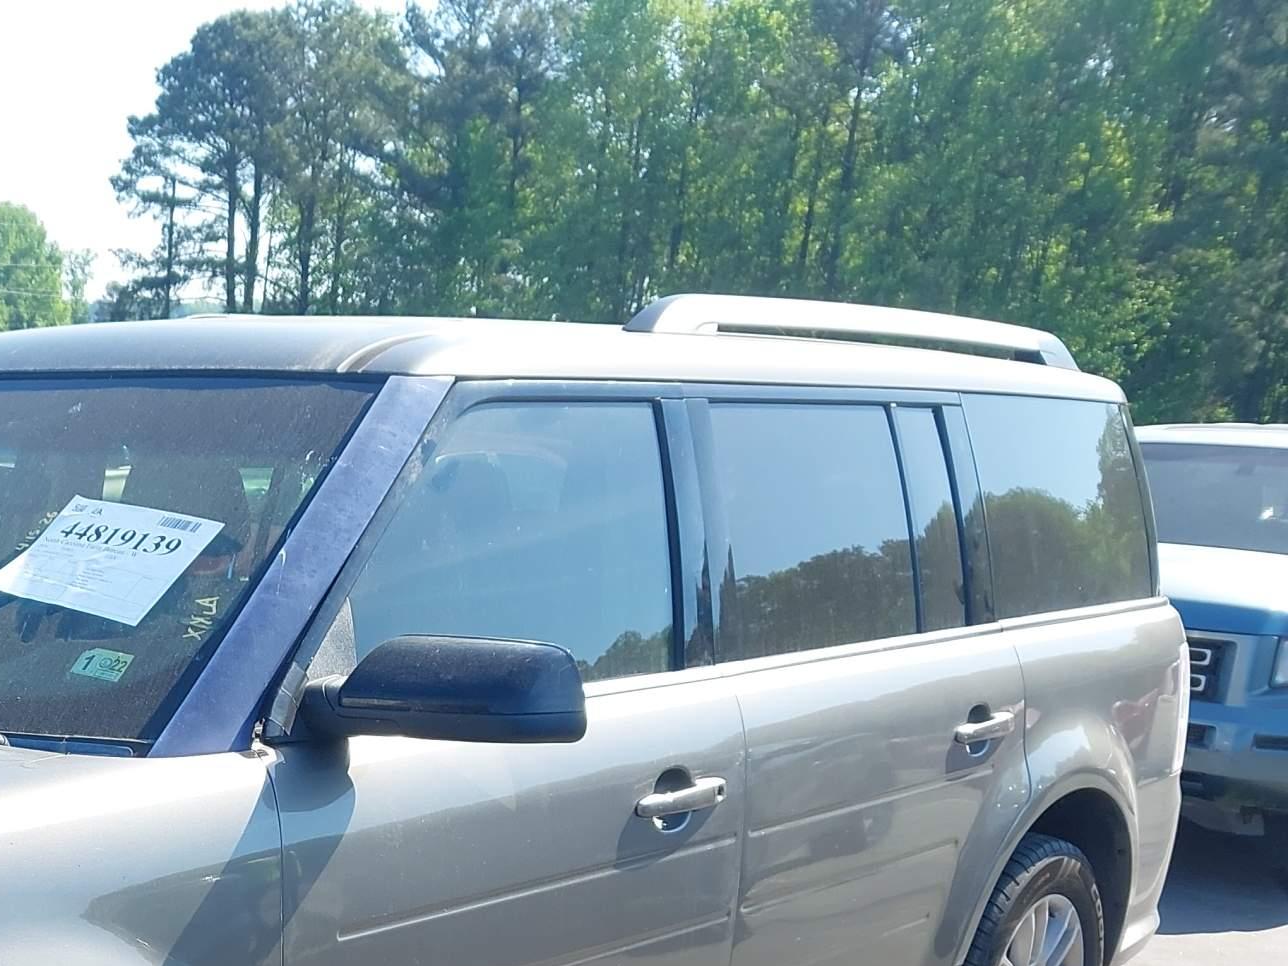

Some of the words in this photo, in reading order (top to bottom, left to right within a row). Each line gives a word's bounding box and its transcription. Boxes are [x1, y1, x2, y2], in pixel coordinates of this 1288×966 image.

[60, 521, 182, 556] 44819139
[81, 654, 96, 671] 1
[112, 659, 128, 673] 22
